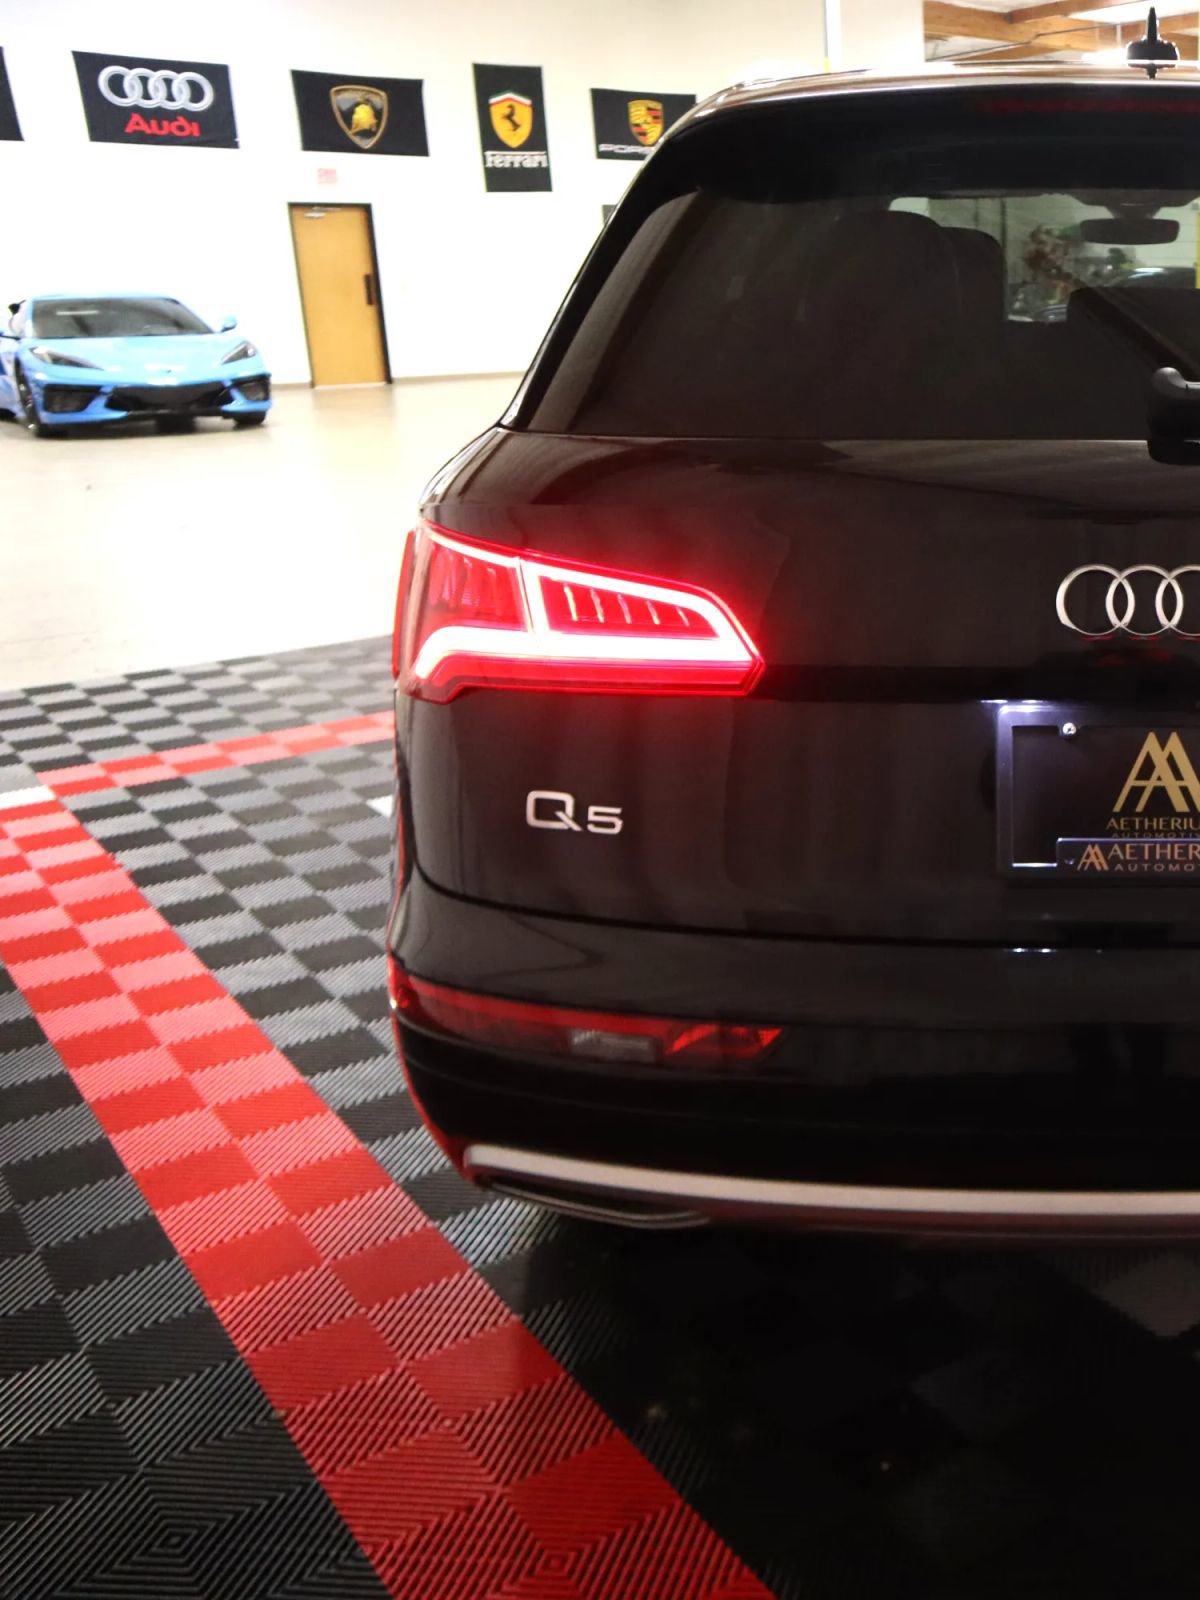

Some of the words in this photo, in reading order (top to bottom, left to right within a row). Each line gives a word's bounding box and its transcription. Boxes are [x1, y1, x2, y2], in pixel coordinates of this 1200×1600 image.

[124, 112, 201, 137] Audi
[484, 151, 548, 168] Ferrari
[526, 790, 623, 835] Q5
